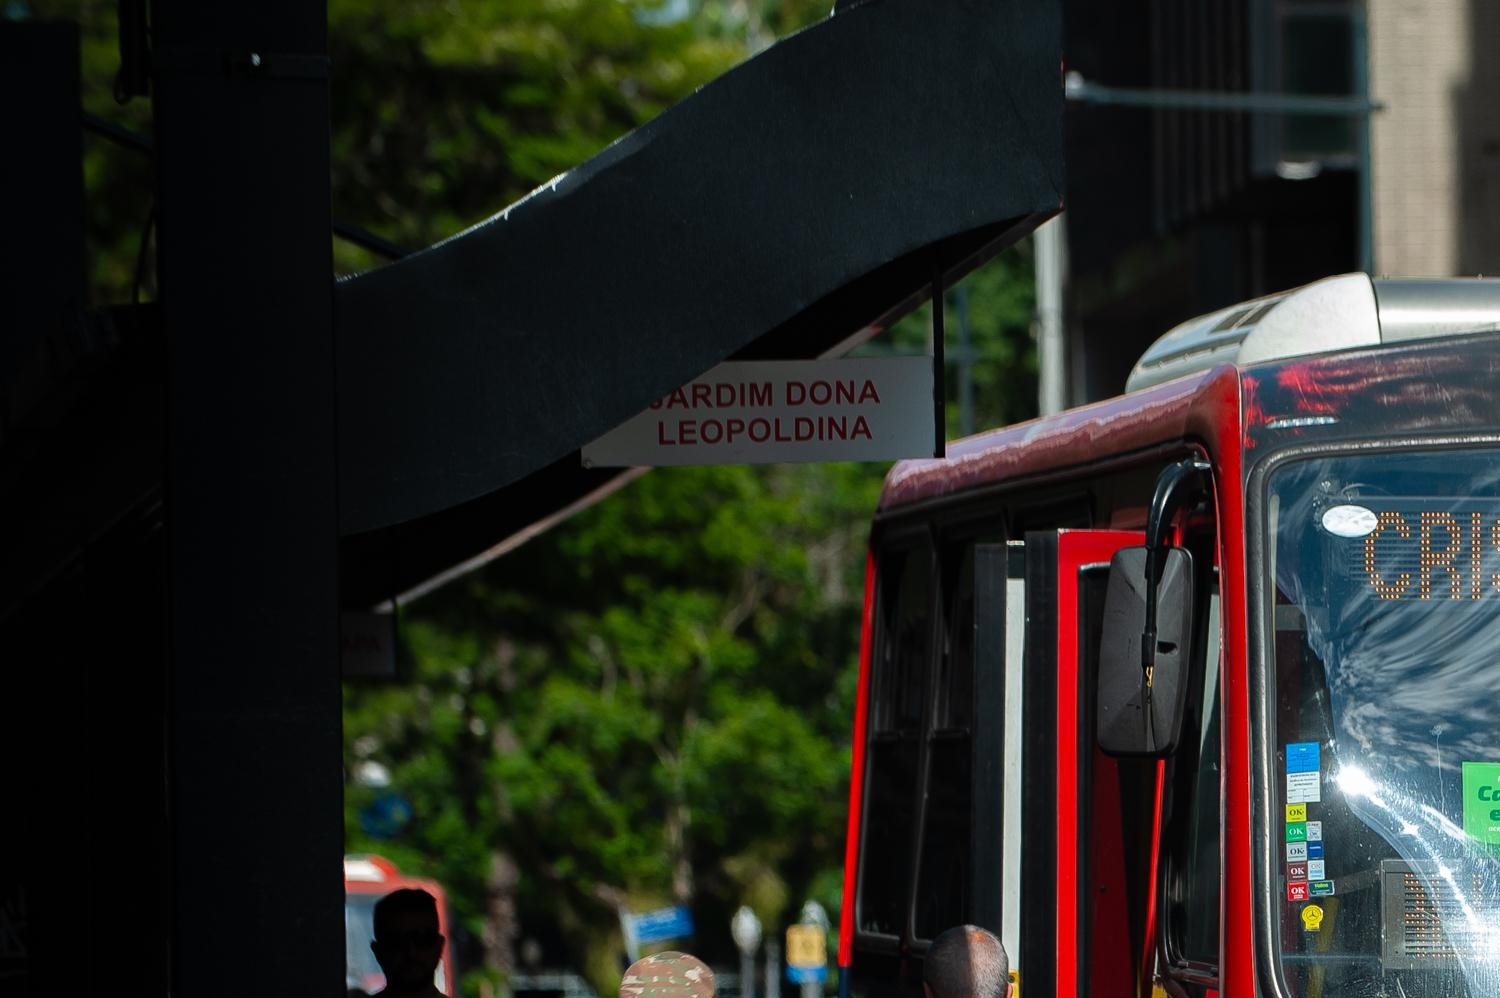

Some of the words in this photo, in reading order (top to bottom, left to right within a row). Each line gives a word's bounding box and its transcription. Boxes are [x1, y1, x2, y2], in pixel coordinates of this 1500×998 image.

[785, 379, 881, 406] DONA
[657, 415, 873, 446] LEOPOLDINA
[1290, 867, 1305, 875] OK
[1290, 887, 1305, 895] OK
